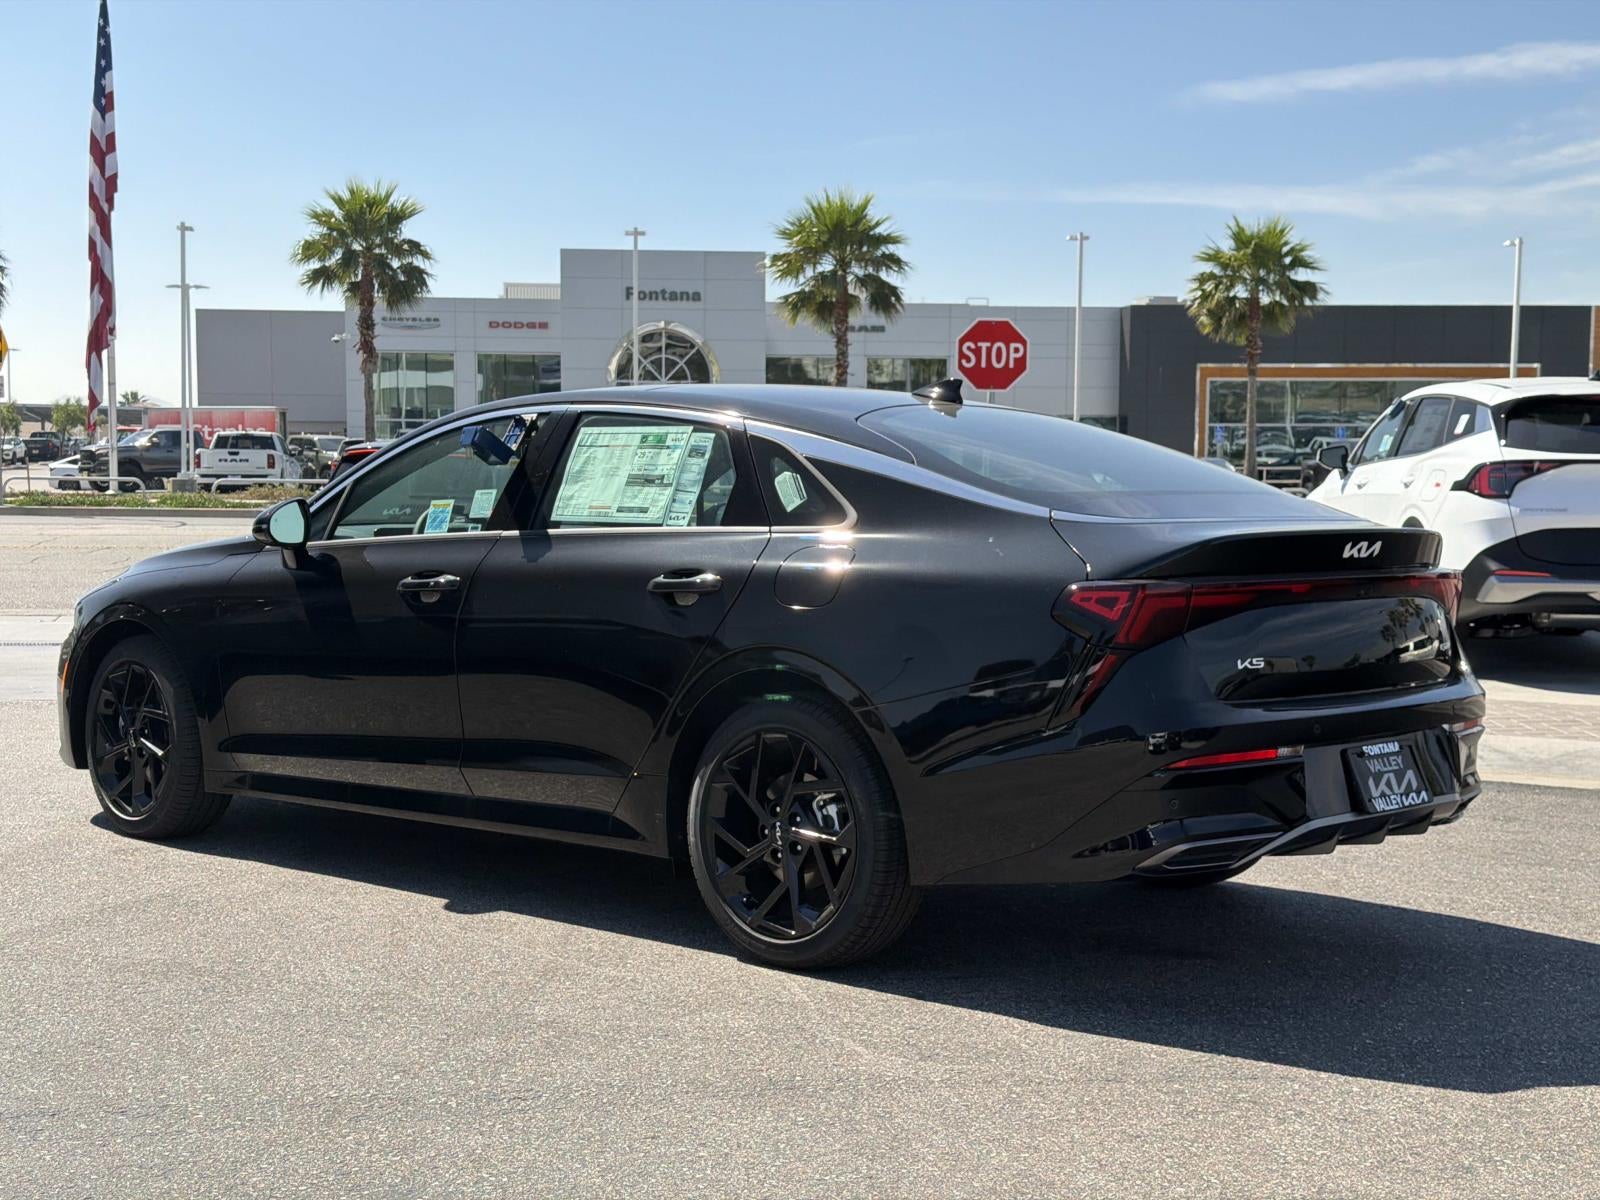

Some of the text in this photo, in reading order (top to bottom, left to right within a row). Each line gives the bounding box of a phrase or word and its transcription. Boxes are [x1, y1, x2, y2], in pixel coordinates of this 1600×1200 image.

[625, 286, 702, 302] Fontana
[488, 320, 549, 330] DODGE
[961, 341, 1024, 369] STOP
[1343, 540, 1382, 559] KIA
[1237, 657, 1265, 670] K5
[1362, 741, 1400, 757] FONTANA
[1366, 755, 1404, 773] VALLEY
[1368, 769, 1418, 798] KIA
[1371, 790, 1428, 812] VALLEY KIA
